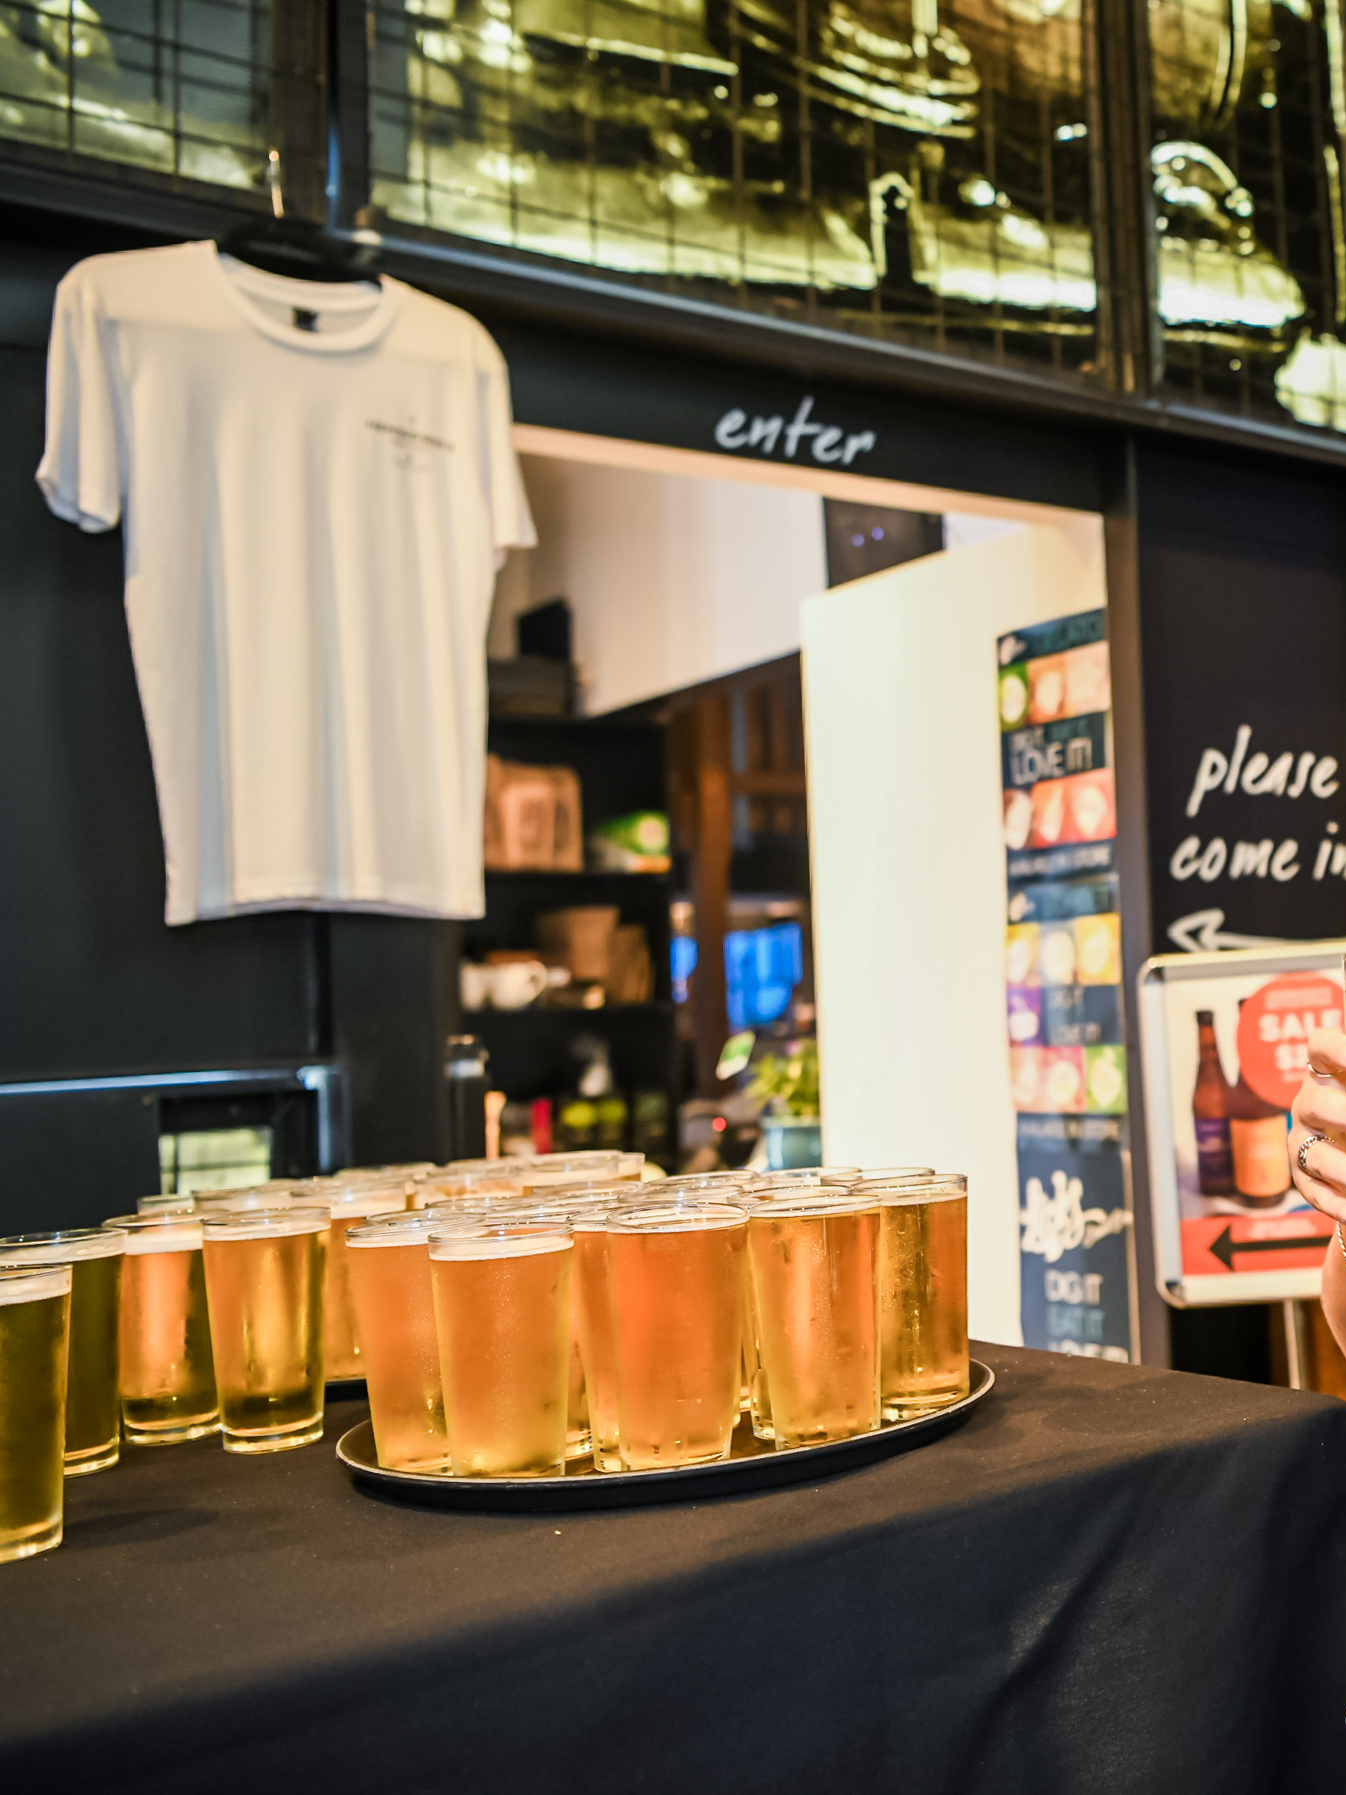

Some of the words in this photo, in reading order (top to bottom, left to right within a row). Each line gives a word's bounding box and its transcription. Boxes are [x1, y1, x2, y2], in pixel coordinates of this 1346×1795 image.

[714, 395, 877, 466] enter
[1186, 724, 1340, 818] please
[1169, 834, 1301, 883] come
